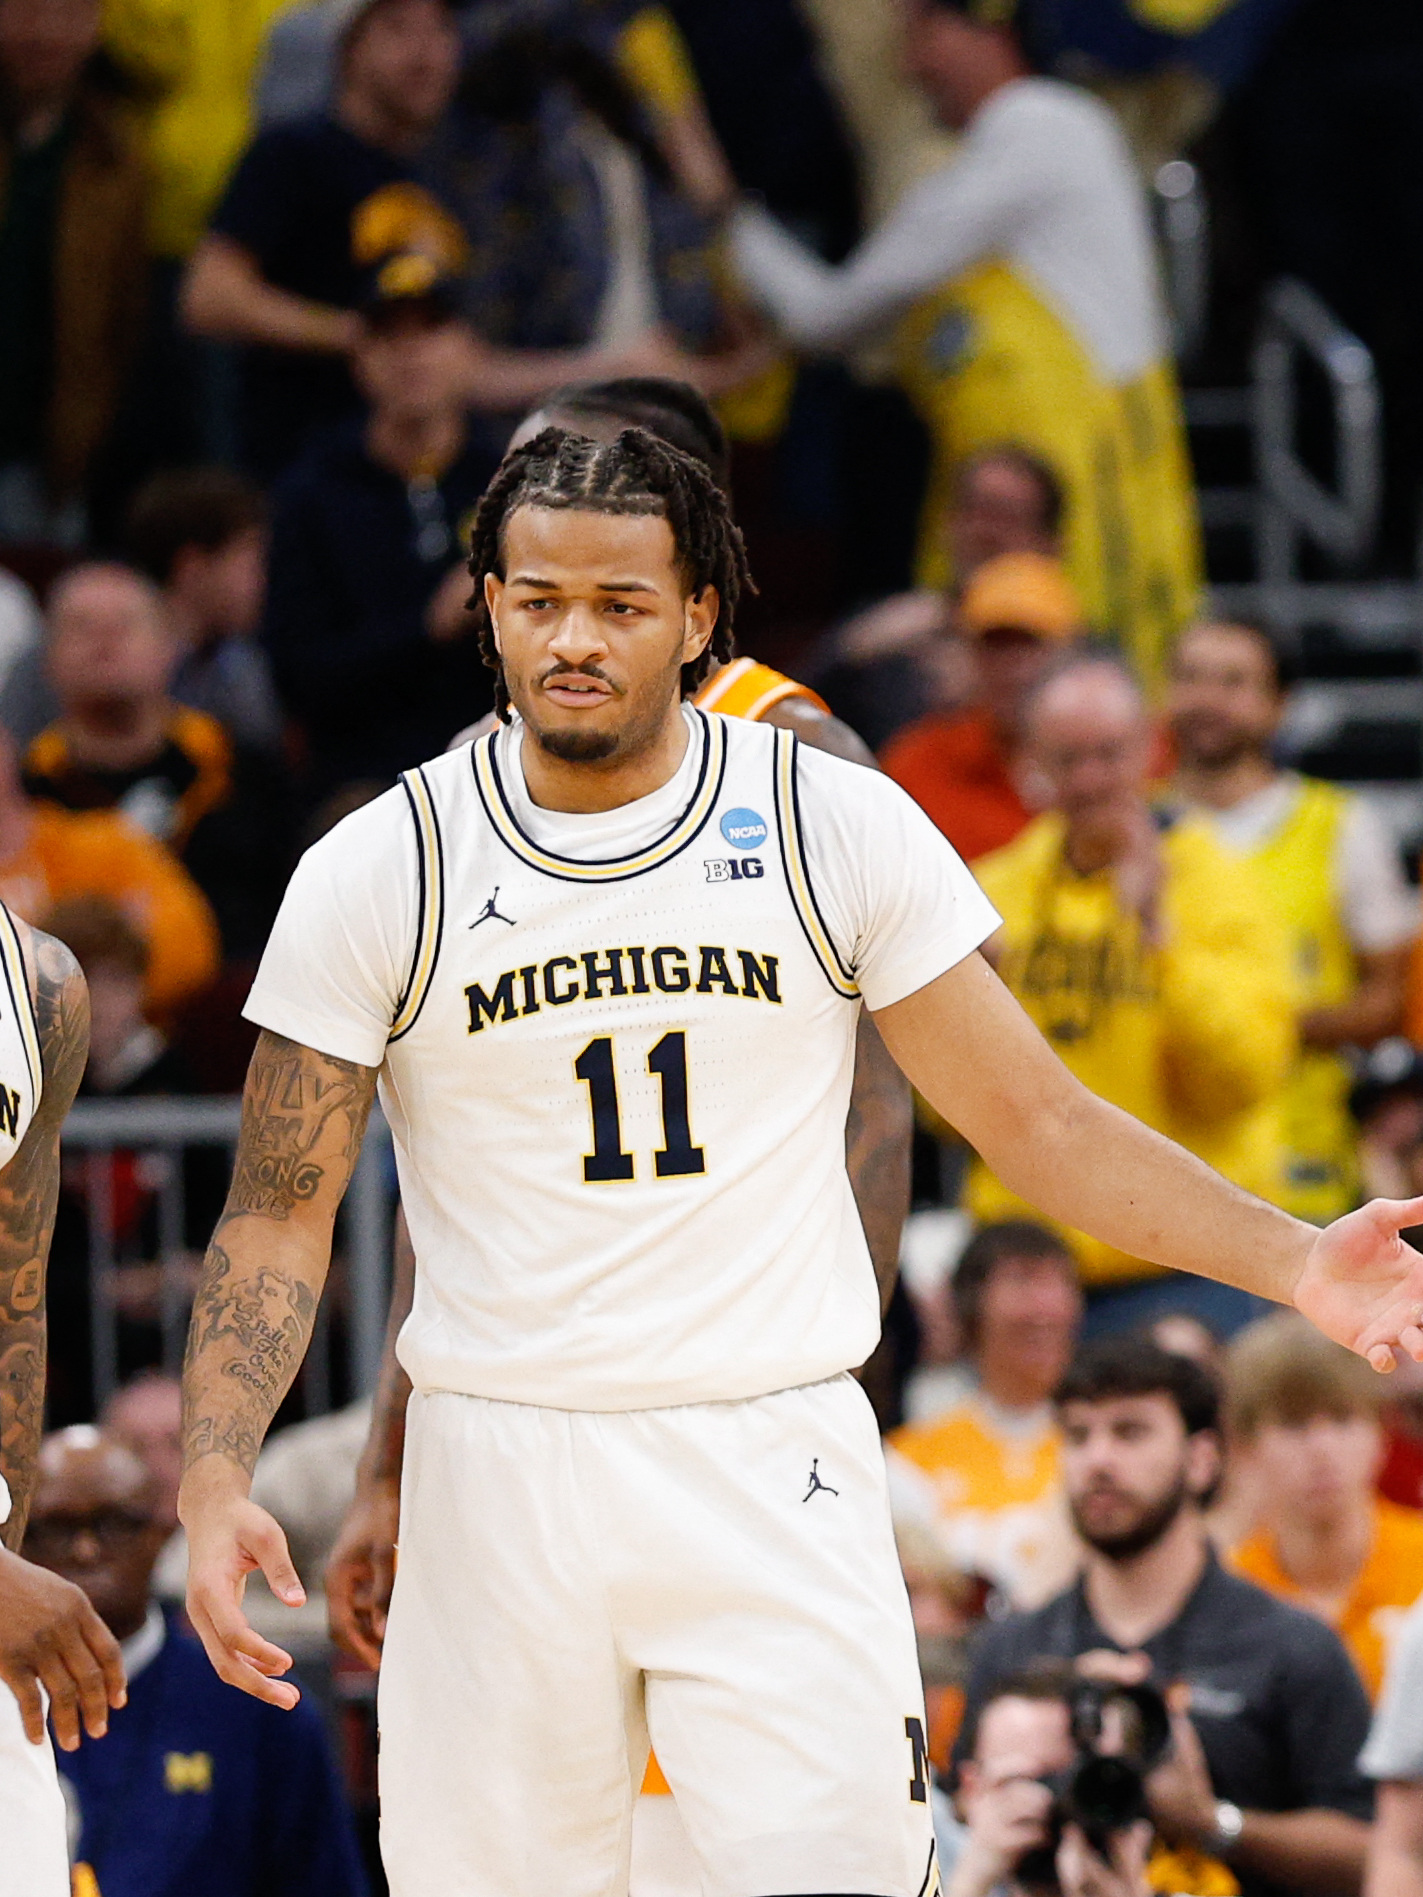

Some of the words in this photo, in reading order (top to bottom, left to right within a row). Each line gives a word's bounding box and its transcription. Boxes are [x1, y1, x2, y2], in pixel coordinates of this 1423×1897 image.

[728, 824, 767, 840] NCAA
[464, 945, 783, 1034] MICHIGAN
[572, 1030, 707, 1183] 11
